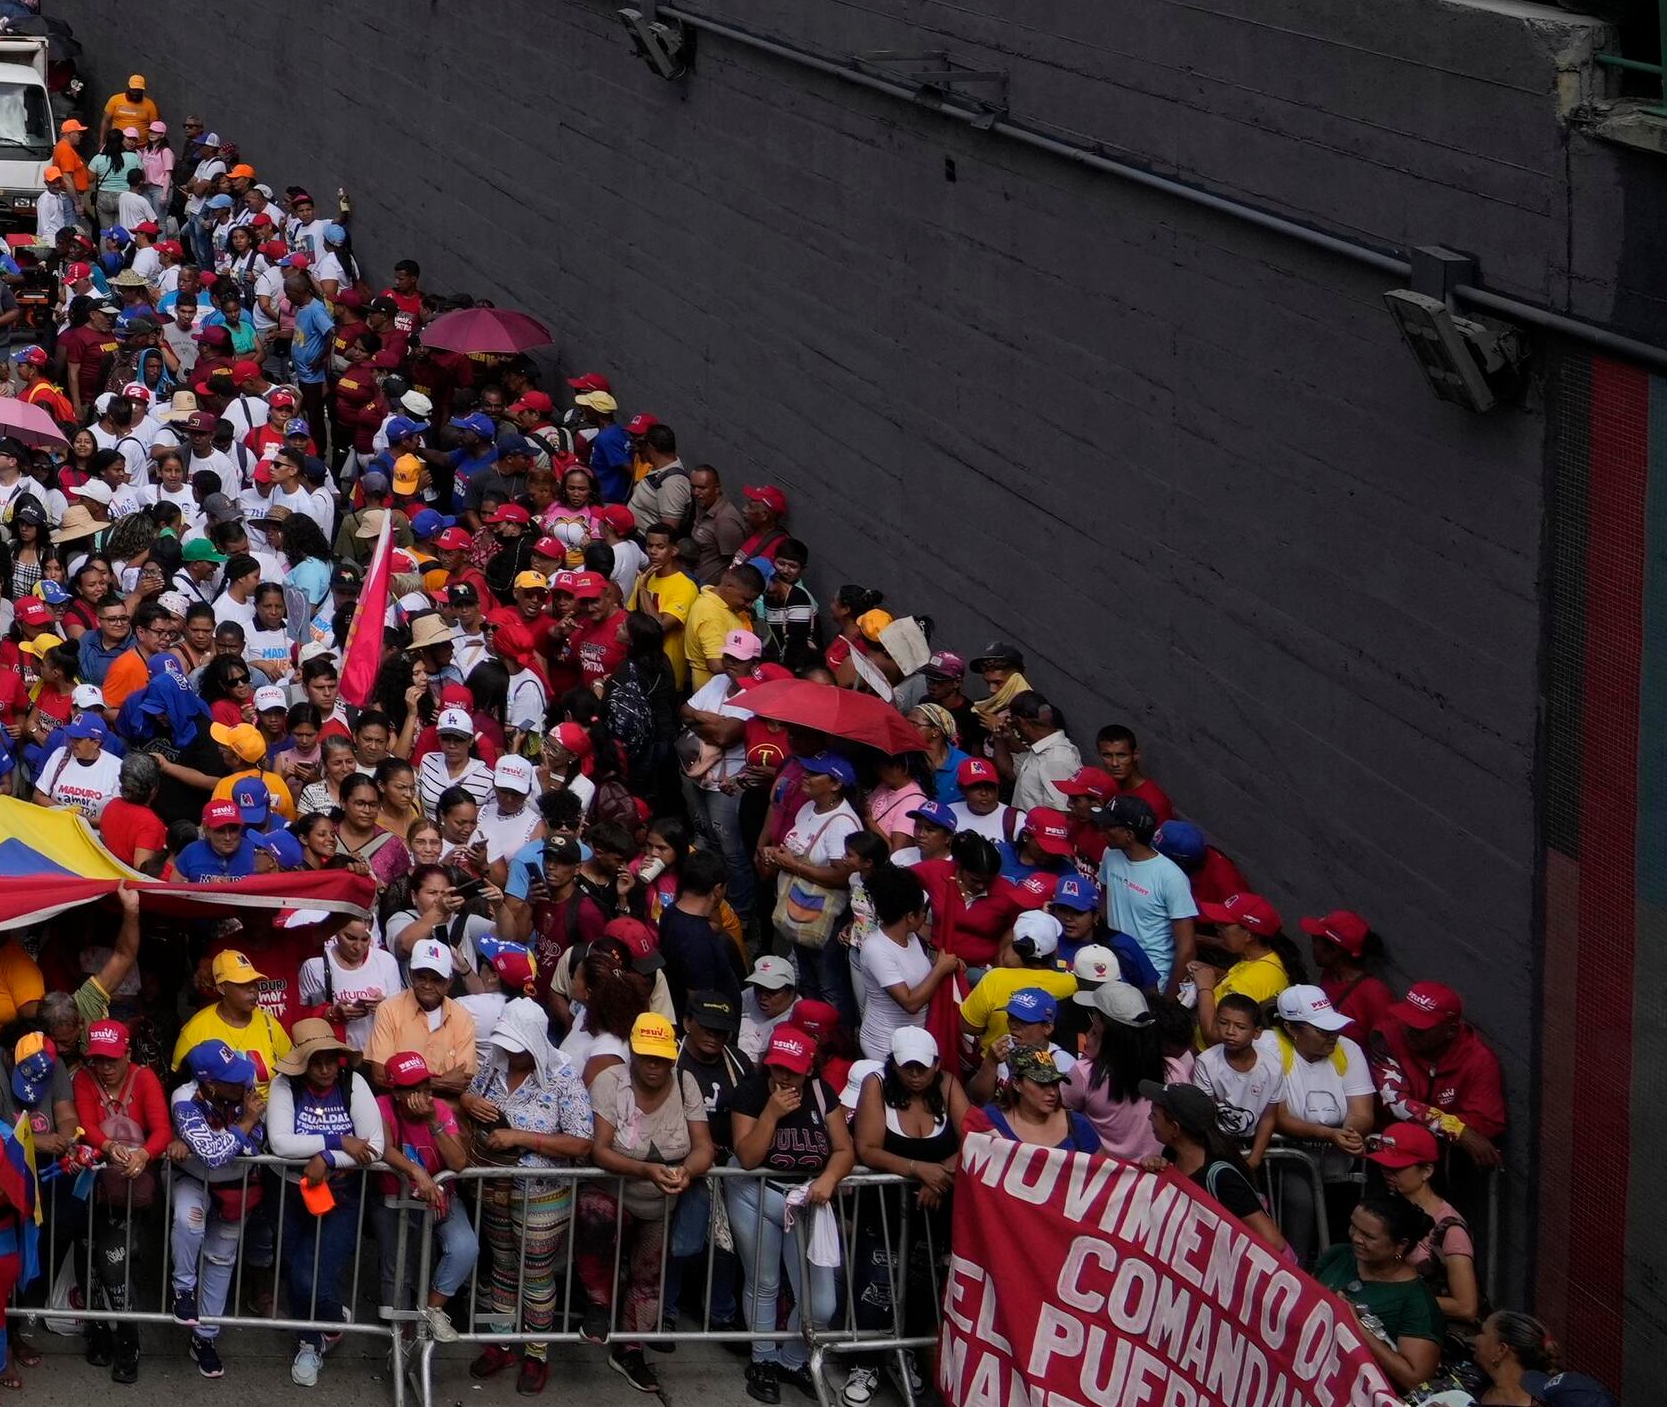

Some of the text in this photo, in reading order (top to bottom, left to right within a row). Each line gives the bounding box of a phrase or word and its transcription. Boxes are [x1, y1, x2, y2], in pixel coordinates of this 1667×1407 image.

[58, 785, 102, 800] MADURO
[943, 1253, 1013, 1357] EL
[961, 1132, 1361, 1406] MOVIMIENTO DE
